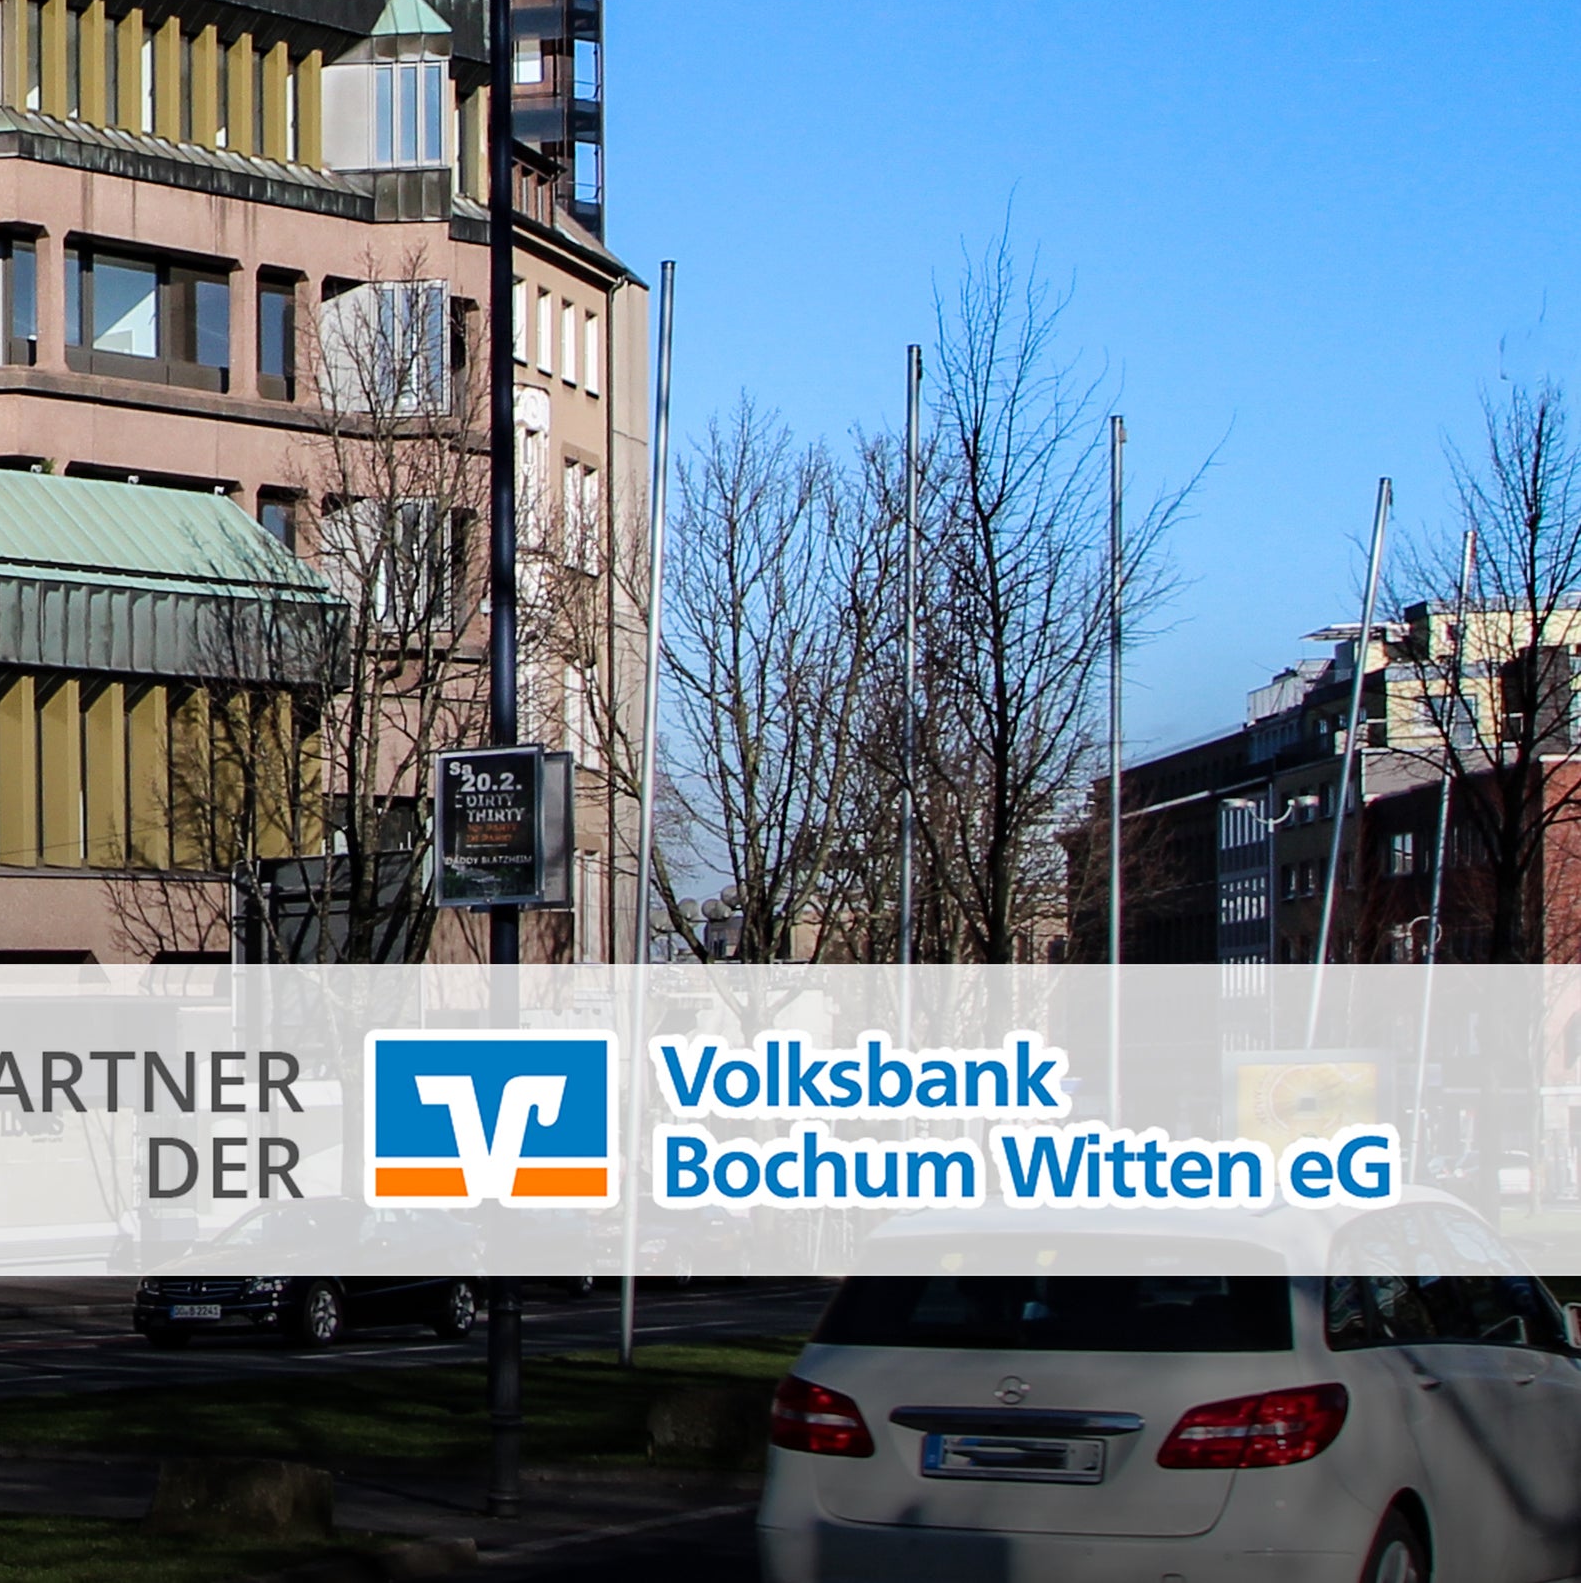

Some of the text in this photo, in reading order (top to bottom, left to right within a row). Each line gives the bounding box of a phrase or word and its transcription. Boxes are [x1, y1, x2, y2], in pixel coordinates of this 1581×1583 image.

[460, 772, 523, 793] 20.2.
[465, 793, 515, 807] DIRTY
[466, 808, 525, 823] THIRTY
